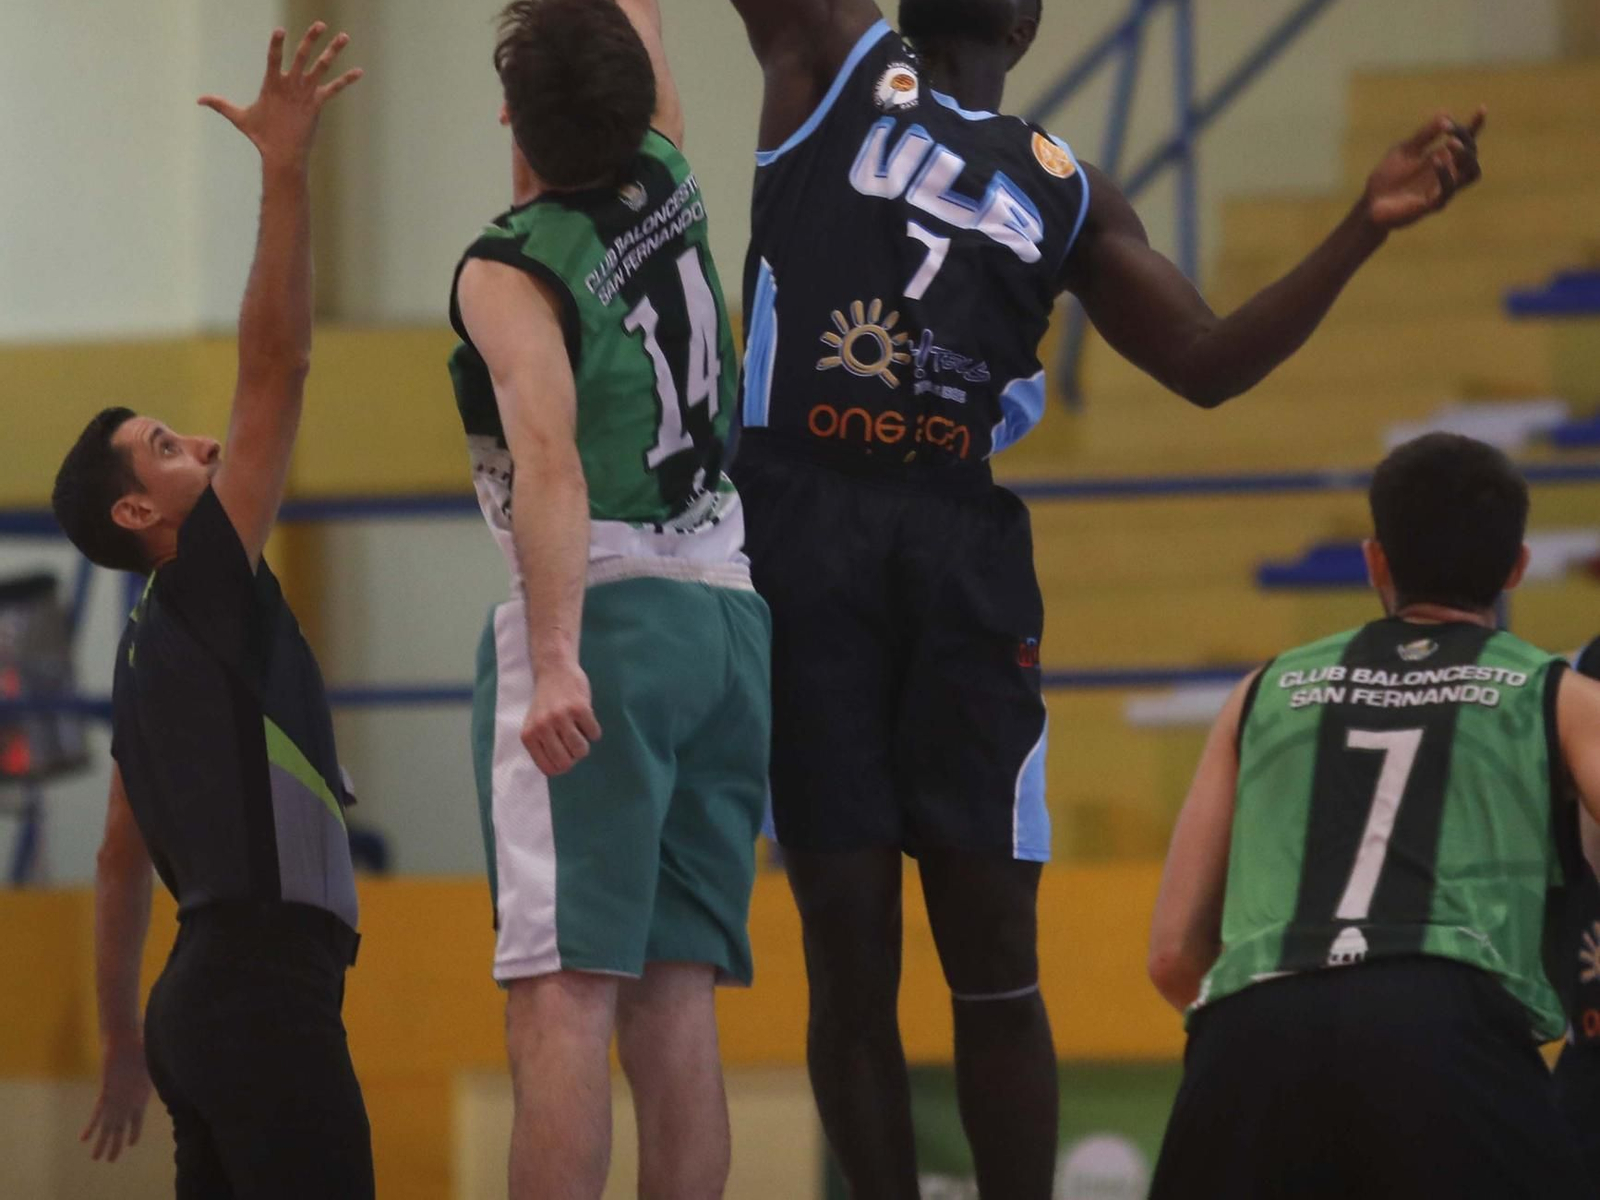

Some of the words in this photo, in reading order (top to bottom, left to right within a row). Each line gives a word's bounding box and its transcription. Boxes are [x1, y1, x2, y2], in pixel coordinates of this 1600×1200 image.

[849, 114, 1044, 264] ULA
[622, 201, 705, 278] FERNANDO
[903, 219, 951, 300] 7
[622, 245, 721, 471] 14
[1279, 665, 1347, 689] CLUB
[1350, 664, 1528, 688] BALONCESTO
[1289, 685, 1346, 709] SAN
[1350, 683, 1500, 708] FERNANDO
[1334, 728, 1424, 920] 7
